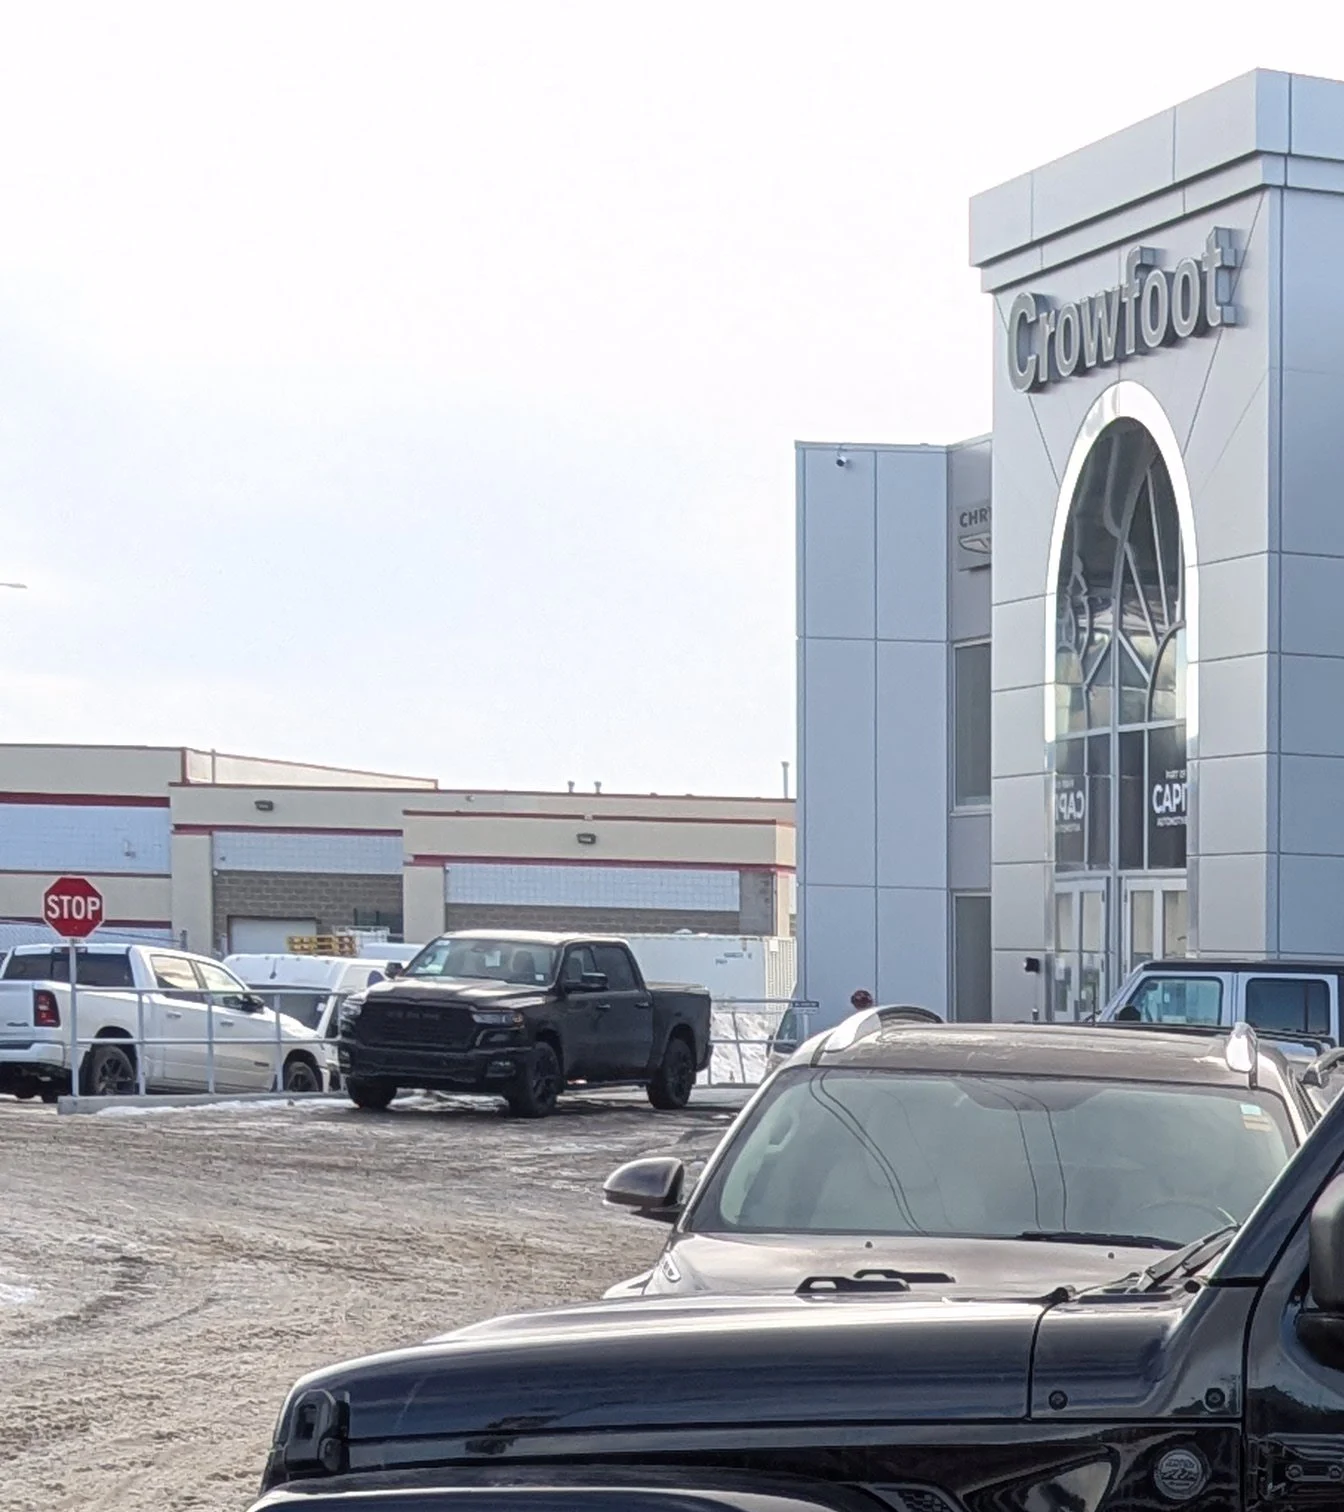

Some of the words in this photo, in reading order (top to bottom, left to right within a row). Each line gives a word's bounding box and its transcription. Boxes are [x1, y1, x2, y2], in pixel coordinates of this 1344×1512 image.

[1007, 225, 1236, 394] Crowfoot
[959, 505, 992, 529] CHR
[1152, 782, 1188, 815] CAPI
[46, 894, 101, 920] STOP
